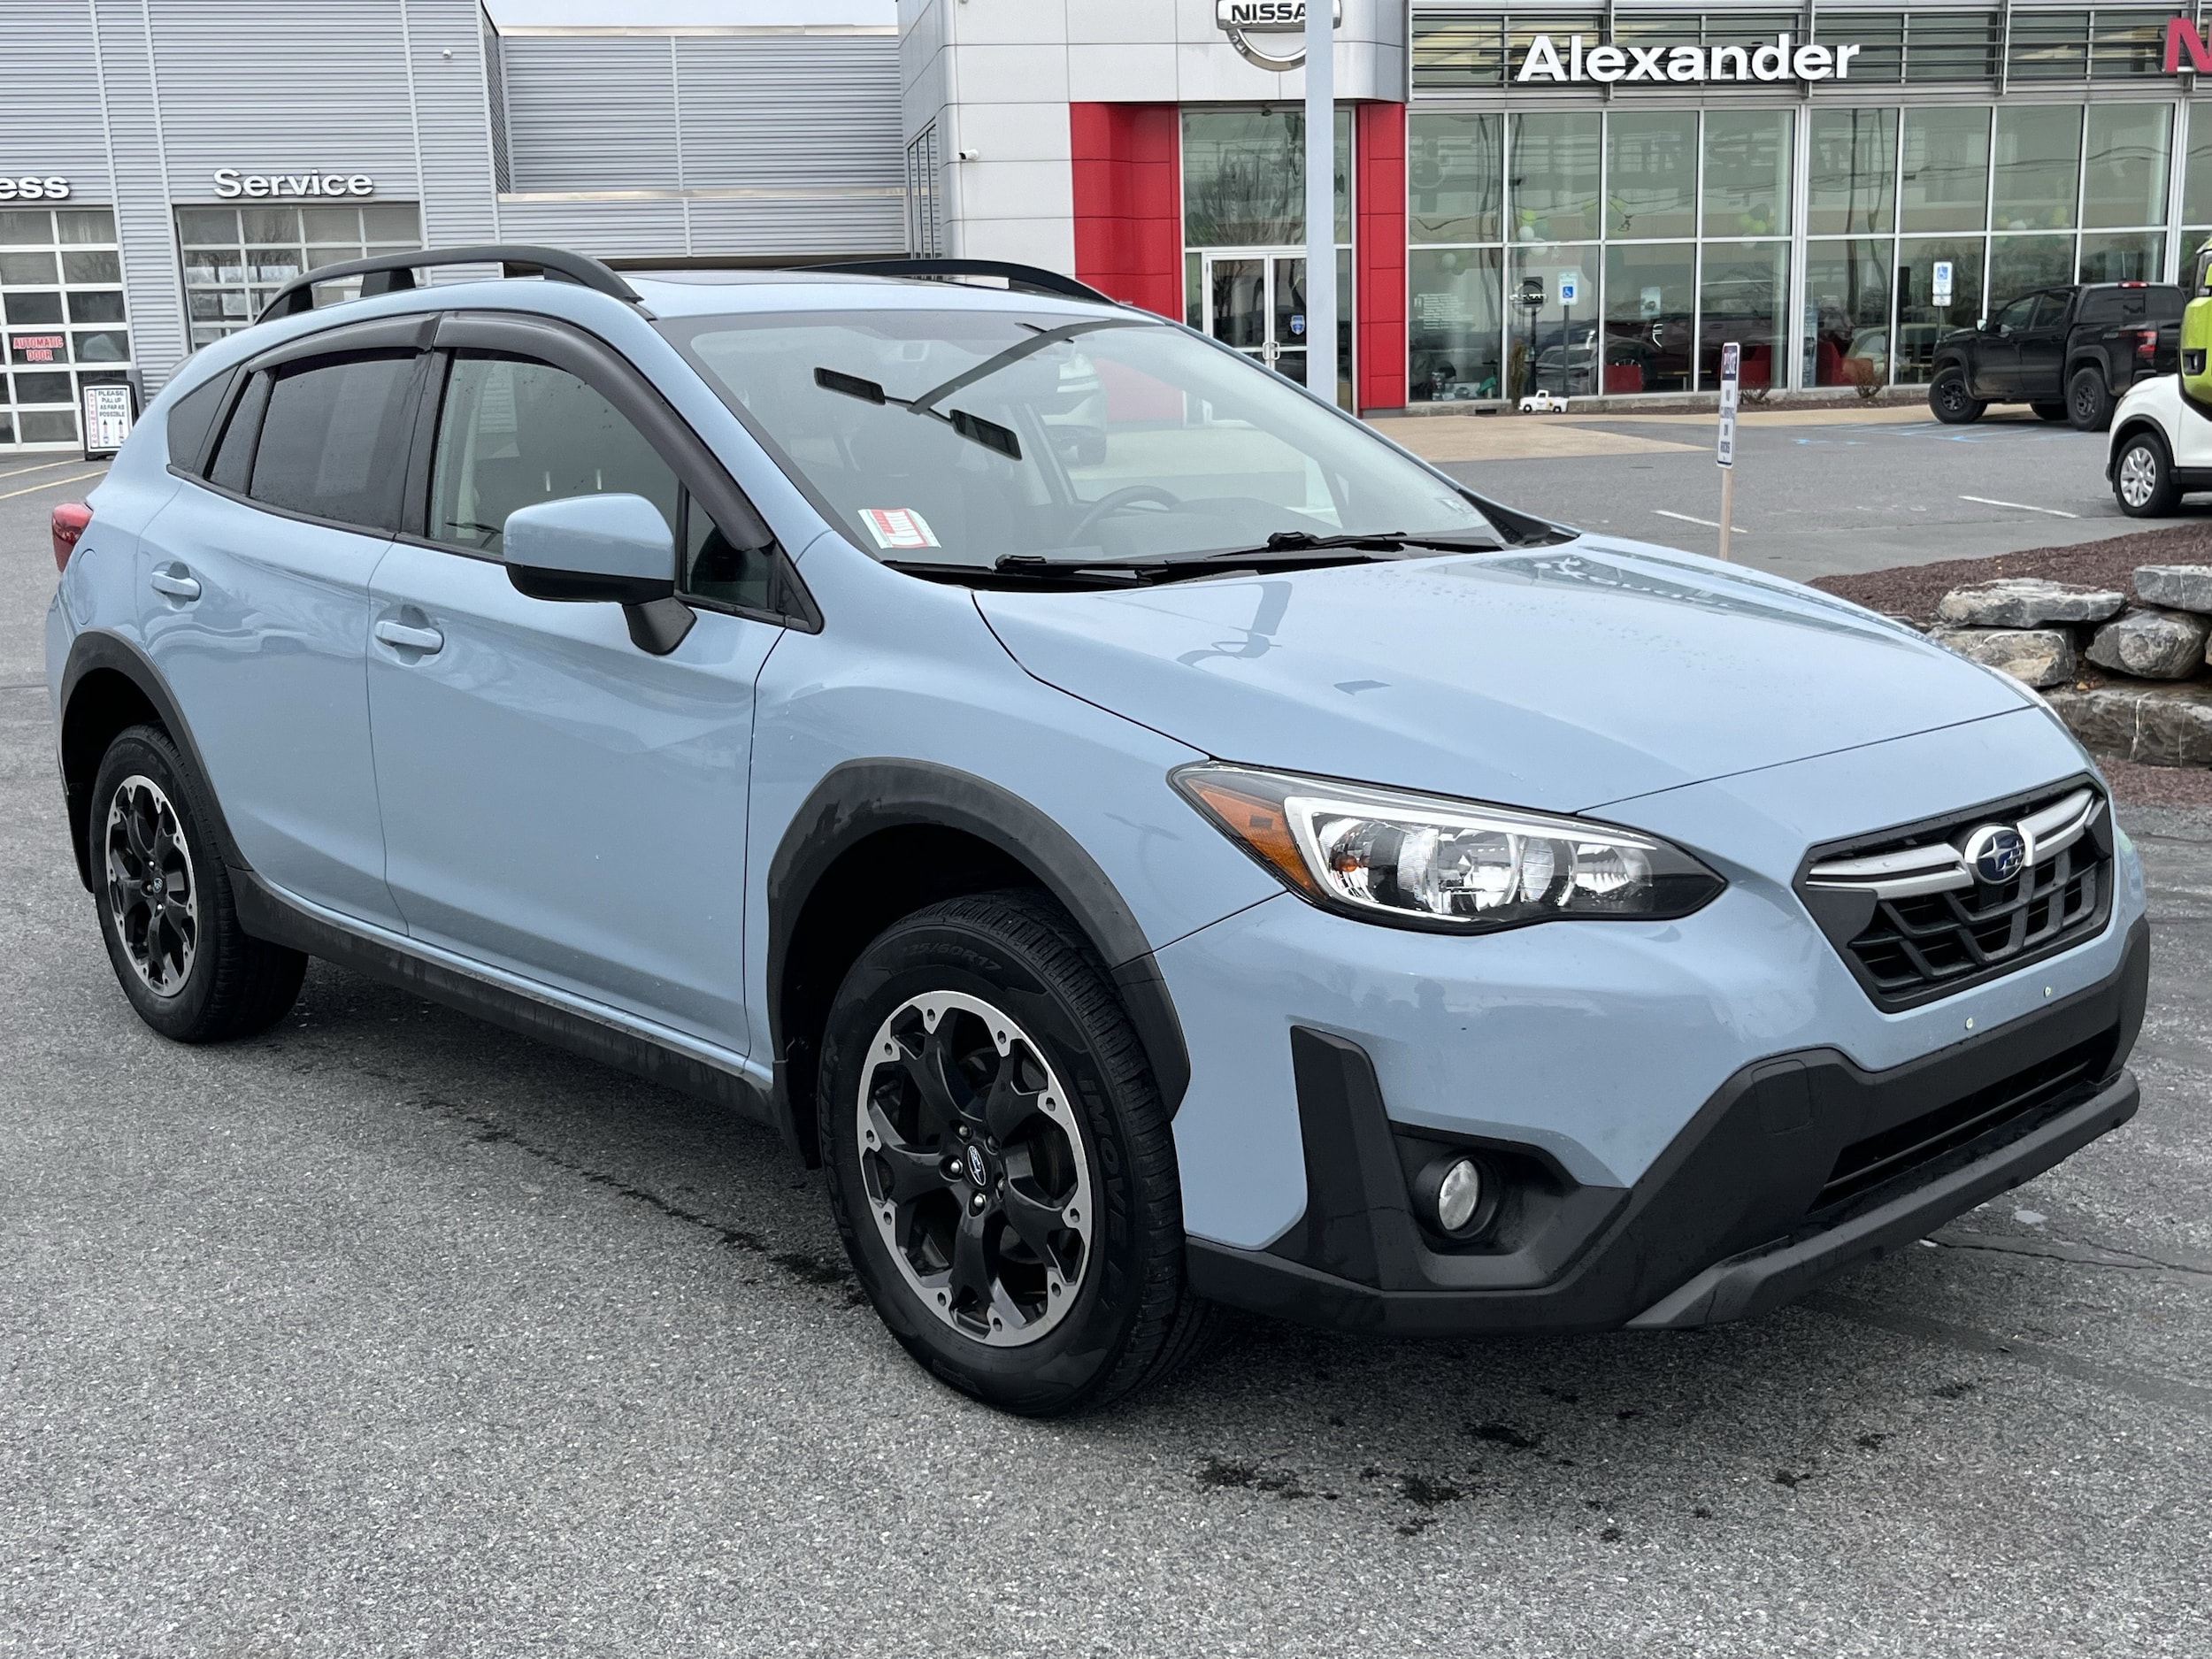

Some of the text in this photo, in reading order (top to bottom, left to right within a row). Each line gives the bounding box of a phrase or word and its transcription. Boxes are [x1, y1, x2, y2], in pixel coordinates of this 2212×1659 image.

[1231, 3, 1306, 22] NISSA
[1515, 17, 2212, 82] Alexander N
[0, 176, 70, 200] ess
[213, 168, 374, 198] Service
[13, 336, 64, 349] AUTOMATIC
[27, 349, 53, 361] DOOR
